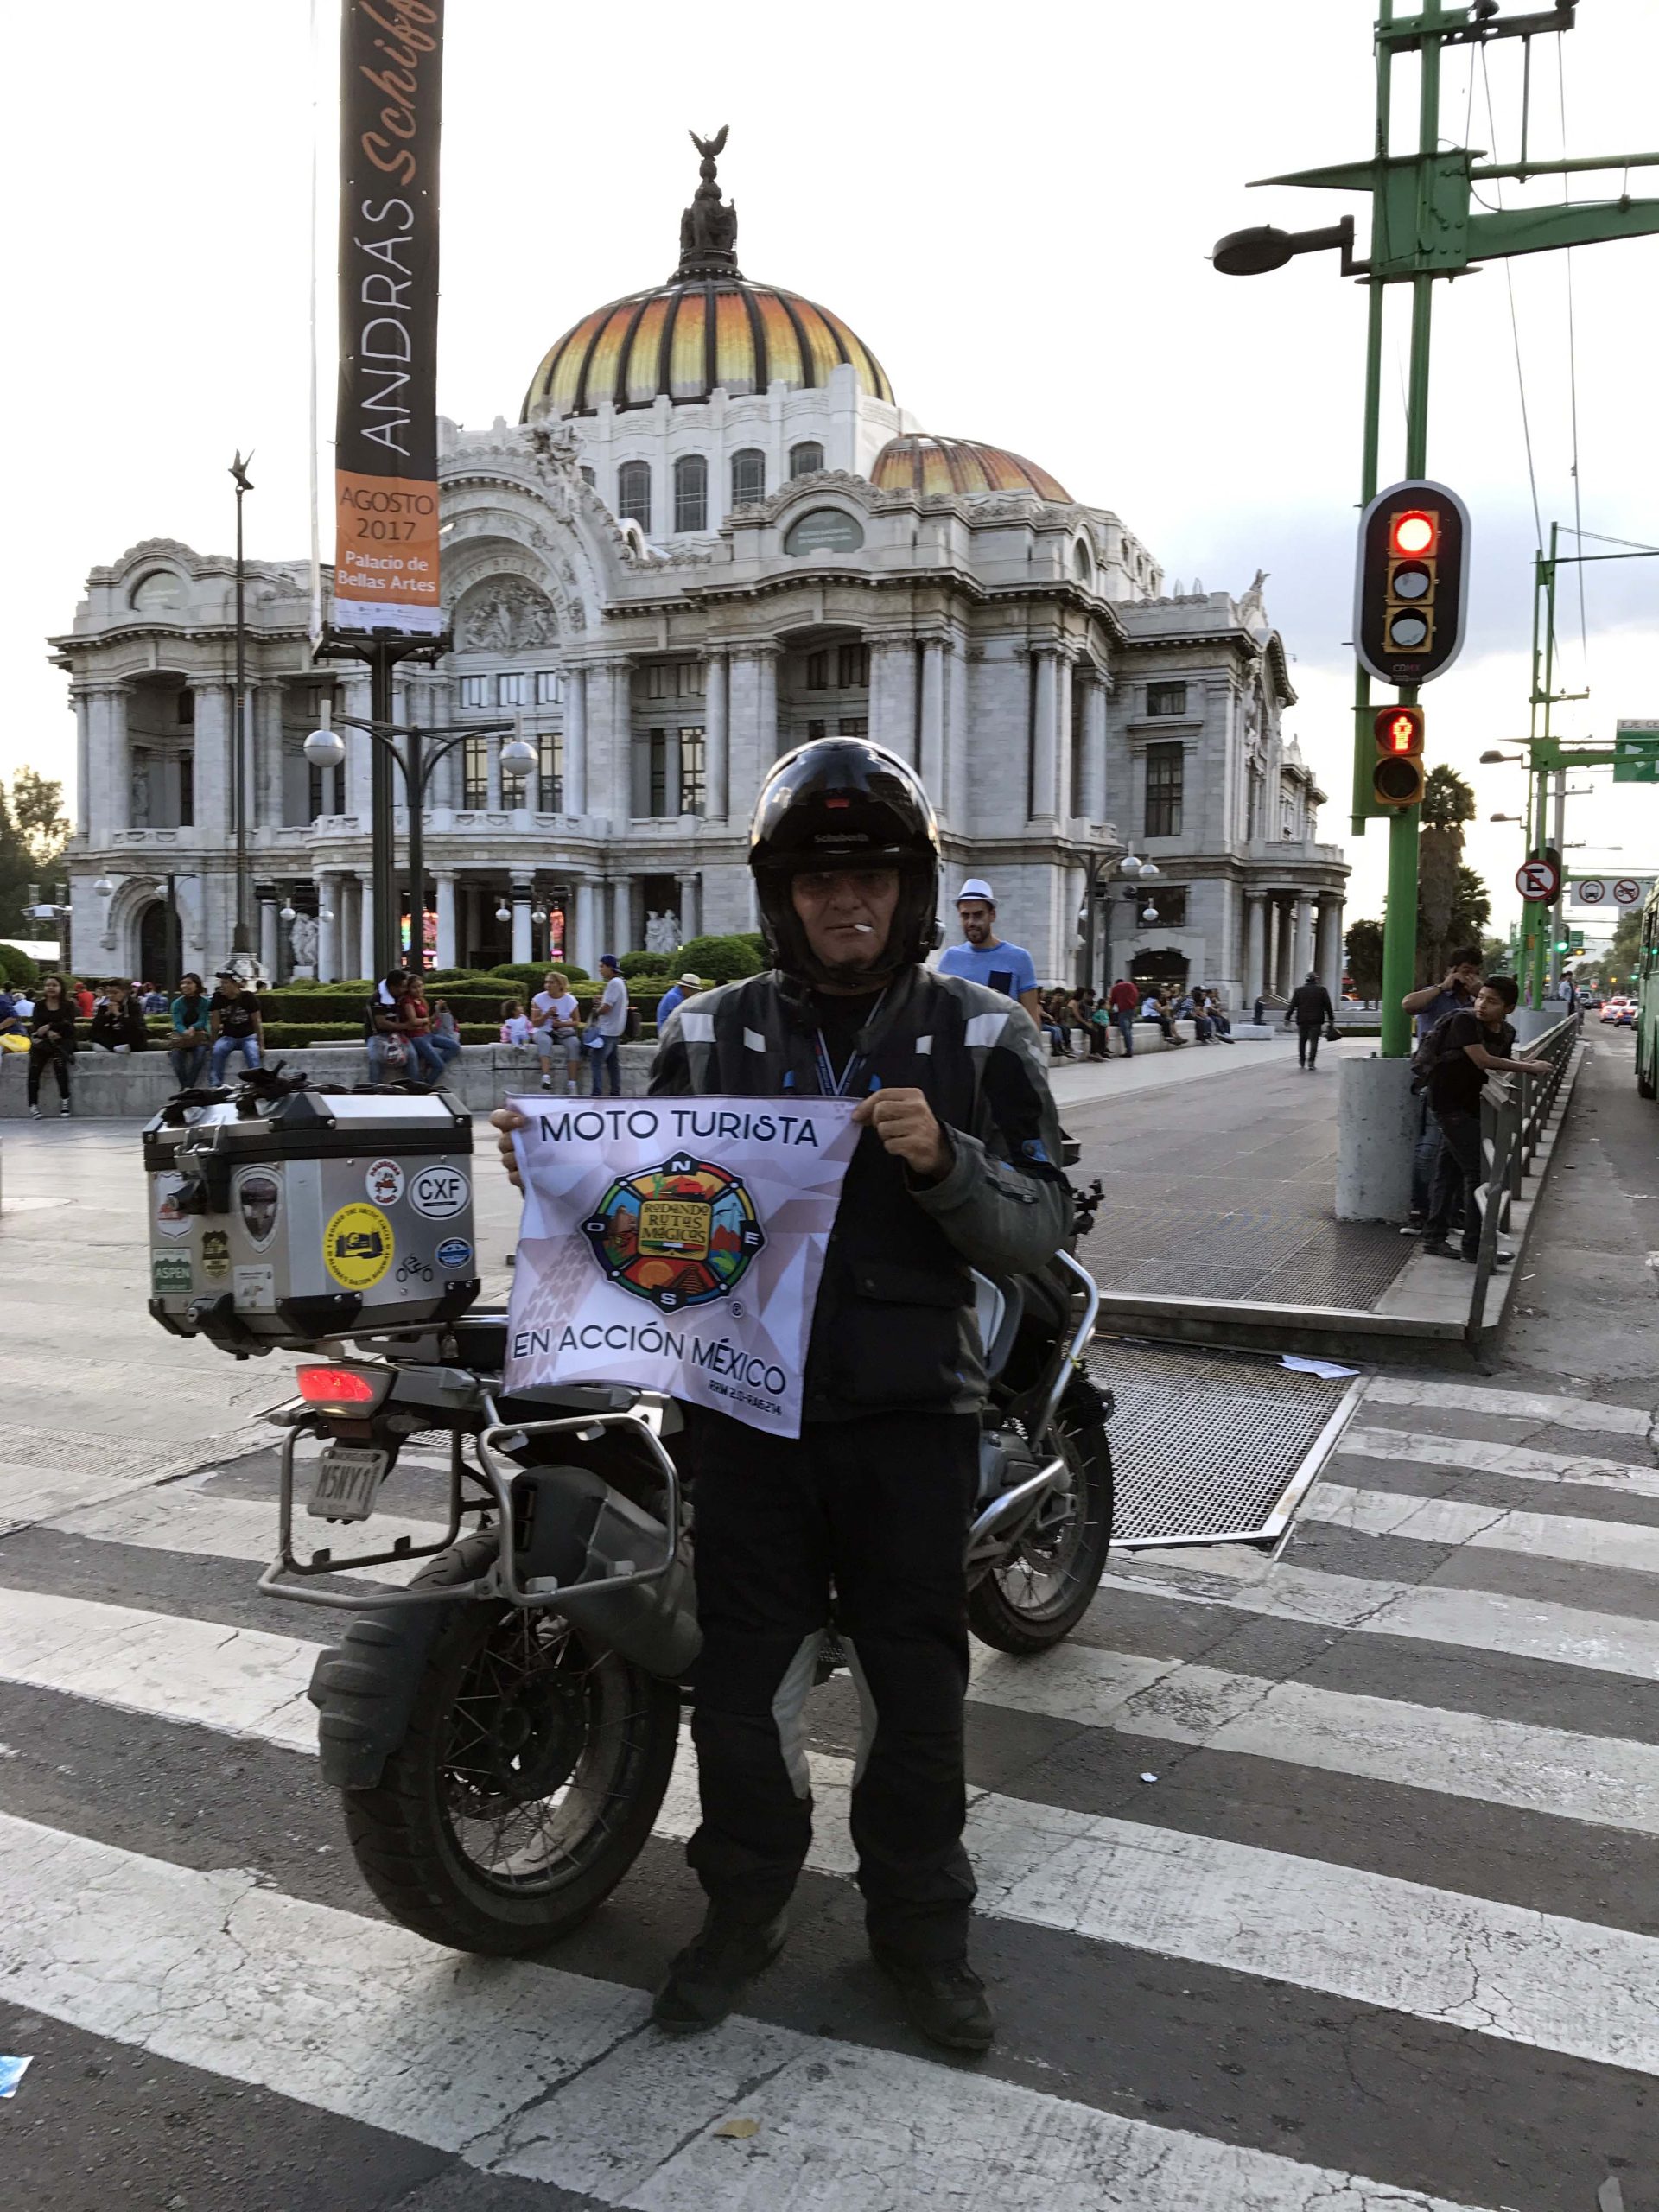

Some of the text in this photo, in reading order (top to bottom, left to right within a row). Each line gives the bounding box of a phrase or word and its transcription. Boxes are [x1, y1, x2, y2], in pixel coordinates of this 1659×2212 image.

[353, 198, 415, 456] ANDRÁS
[340, 486, 434, 516] AGOSTO
[357, 518, 417, 542] 2017
[345, 550, 429, 572] Palacio de
[338, 570, 436, 593] Bellas Artes
[540, 1109, 819, 1148] MOTO TURISTA
[671, 1160, 691, 1172] N
[419, 1178, 461, 1201] CXF
[743, 1231, 760, 1245] E
[155, 1267, 190, 1279] ASPEN
[659, 1292, 677, 1306] S
[513, 1321, 787, 1395] EN ACCIÓN MÉXICO
